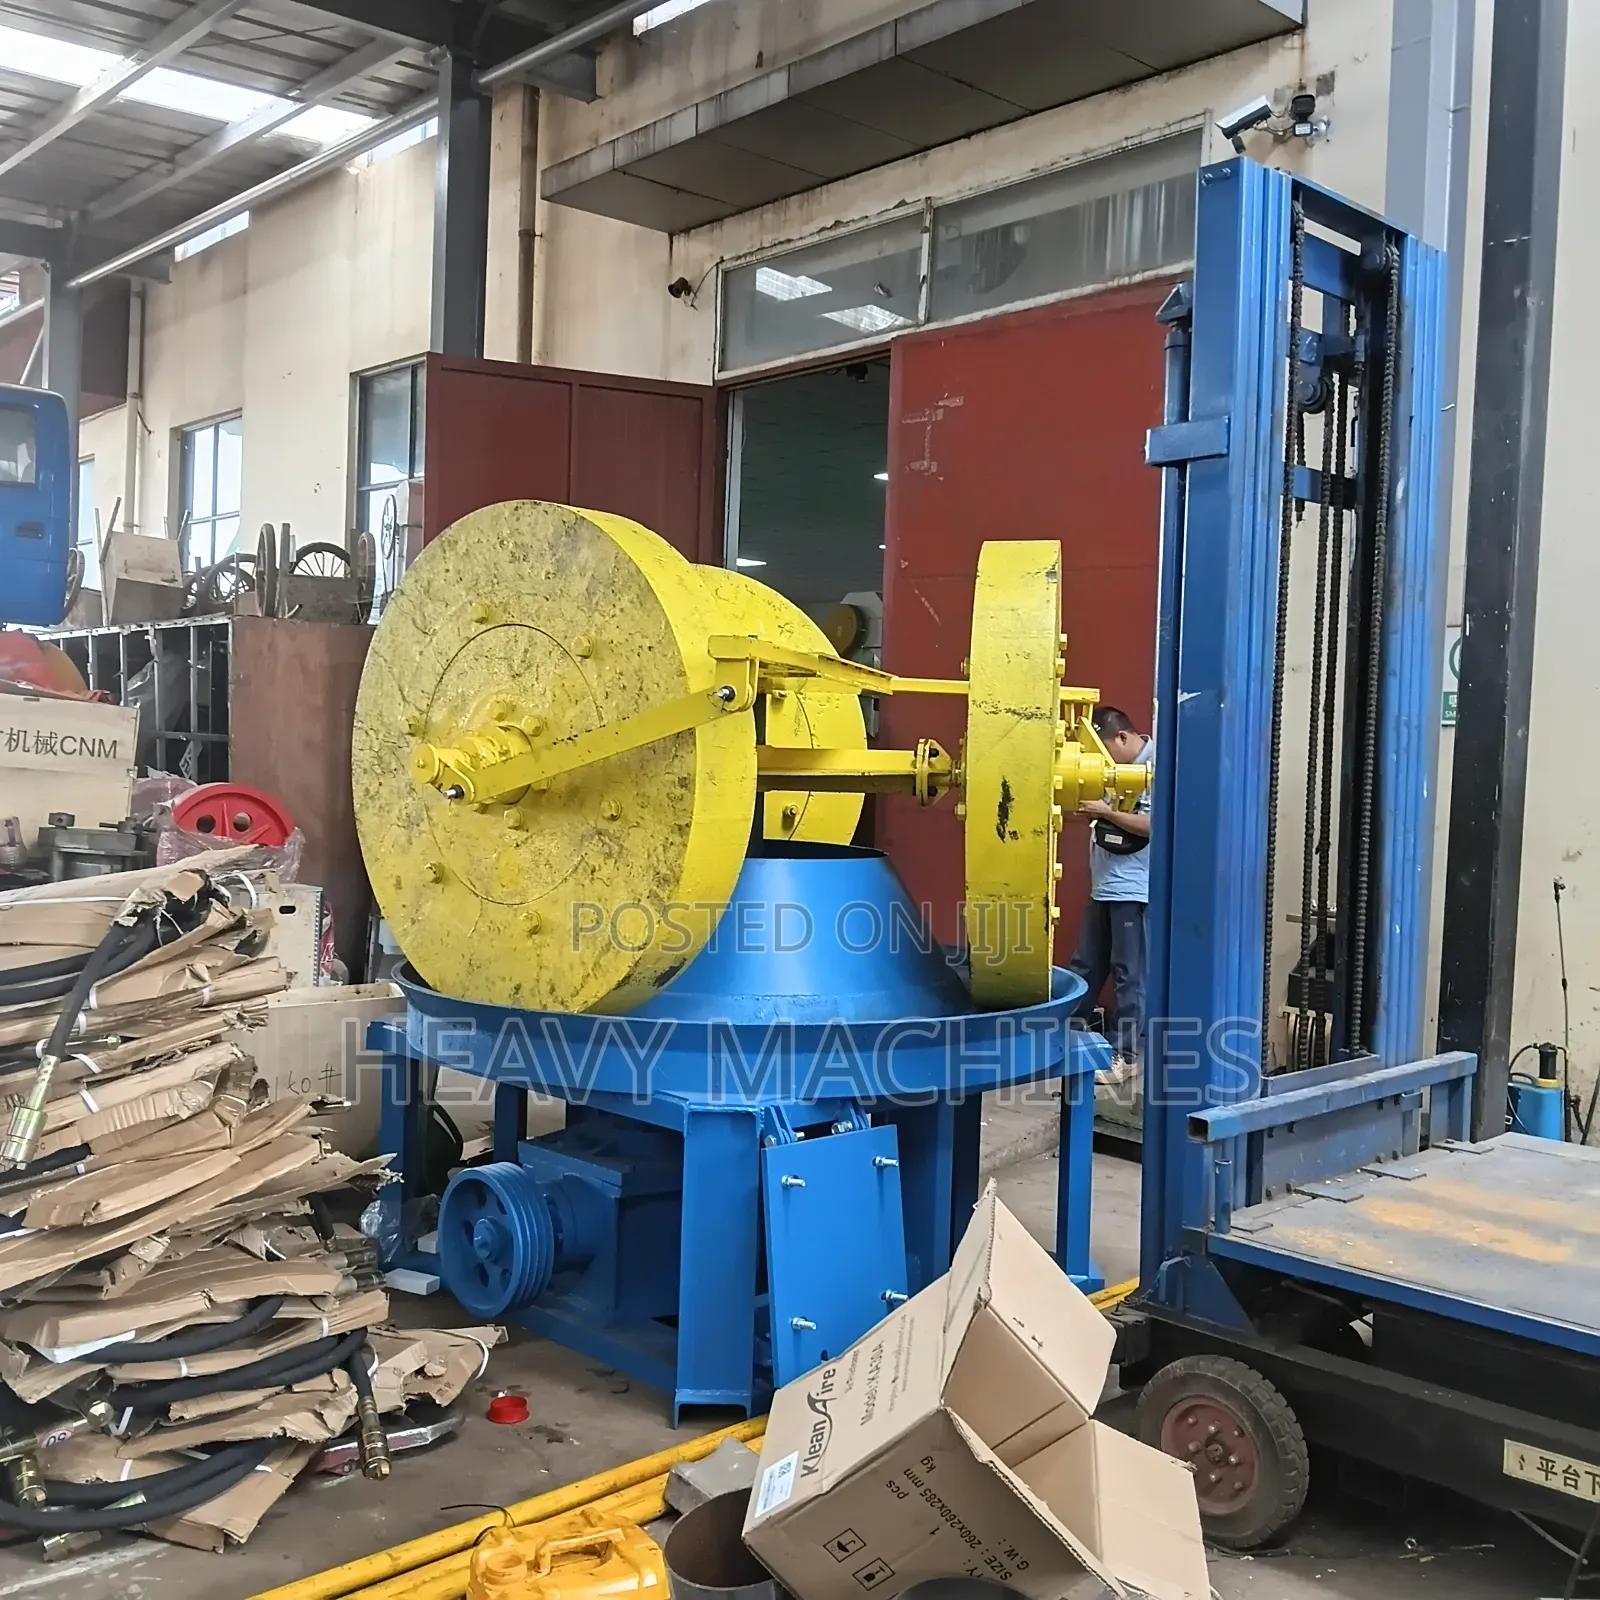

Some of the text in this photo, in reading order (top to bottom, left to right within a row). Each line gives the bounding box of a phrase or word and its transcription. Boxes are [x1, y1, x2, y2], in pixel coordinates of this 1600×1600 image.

[0, 727, 118, 759] 机械CNM
[920, 1455, 937, 1473] kg
[903, 1468, 924, 1488] mm
[886, 1480, 910, 1500] pcs
[919, 1488, 982, 1549] 260x260x285
